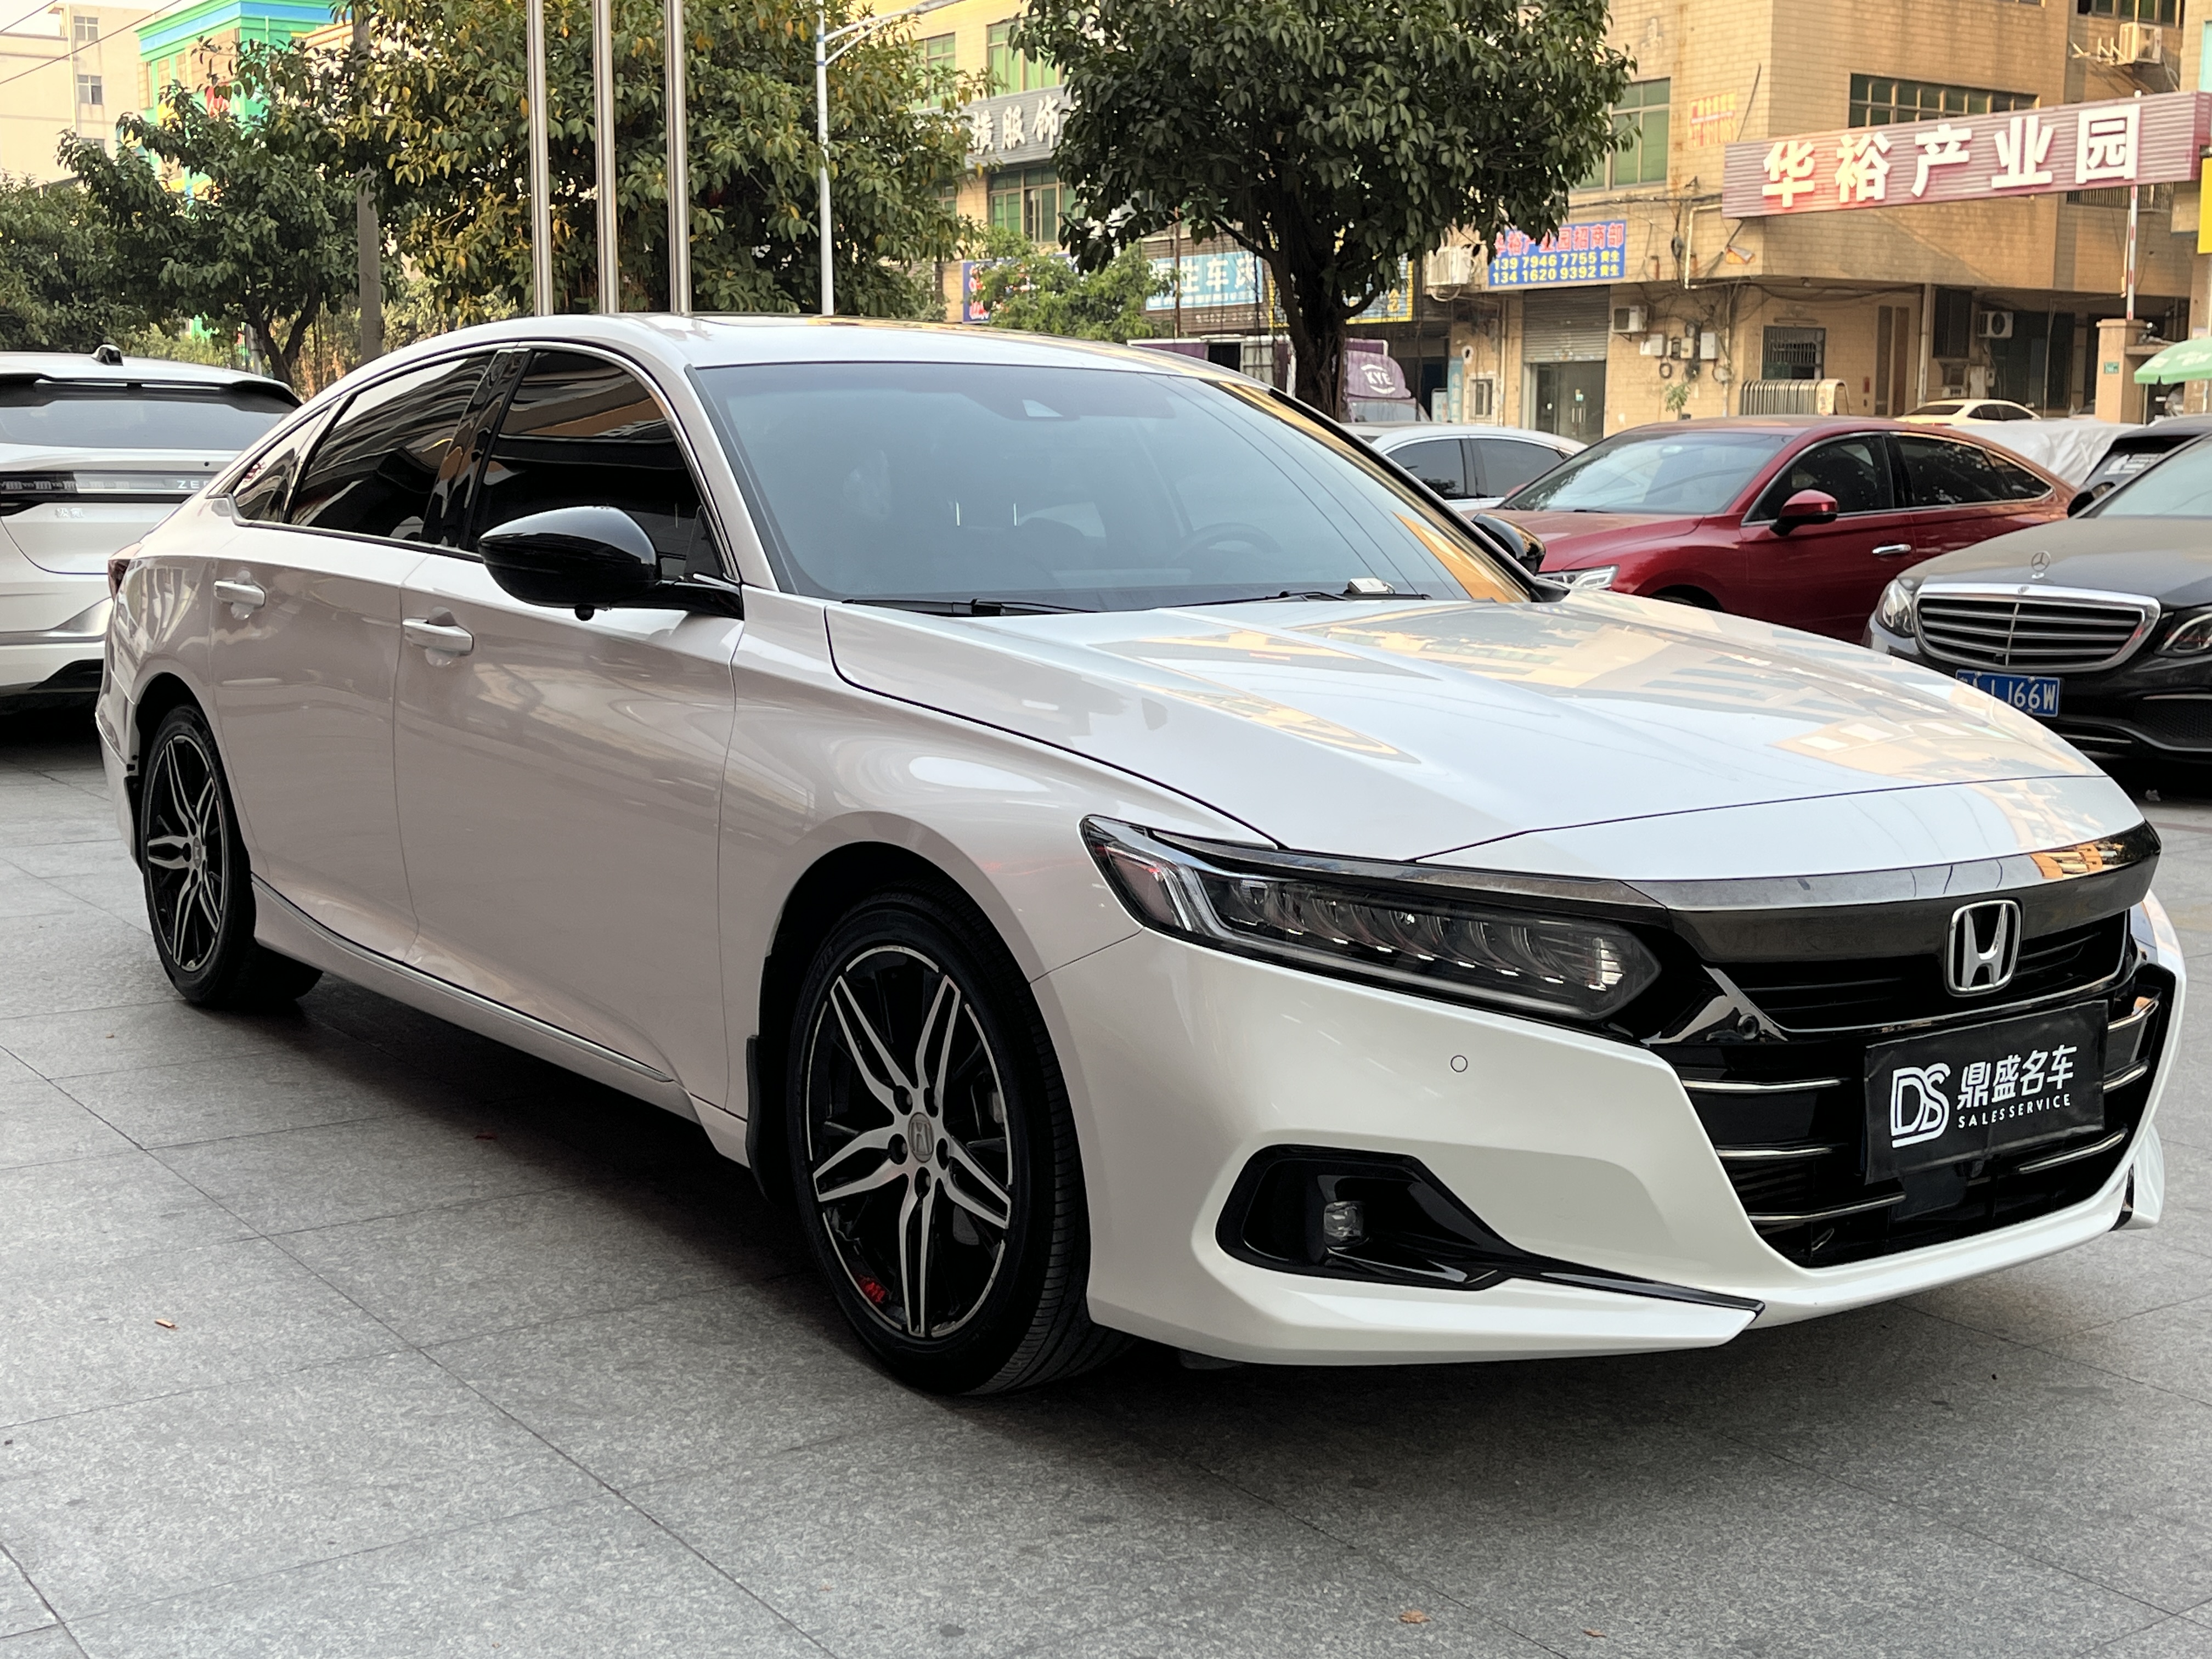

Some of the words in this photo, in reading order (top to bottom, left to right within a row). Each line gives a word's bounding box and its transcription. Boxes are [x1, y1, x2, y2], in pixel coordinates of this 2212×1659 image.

[1762, 104, 2140, 208] 华裕产业园
[1493, 258, 1518, 270] 139
[1522, 254, 1557, 268] 7946
[1561, 251, 1596, 266] 7755
[1493, 271, 1517, 284] 134
[1522, 268, 1557, 282] 1620
[1560, 266, 1596, 279] 9392
[1365, 371, 1393, 385] KYE
[1957, 1045, 2078, 1110] 鼎盛名车
